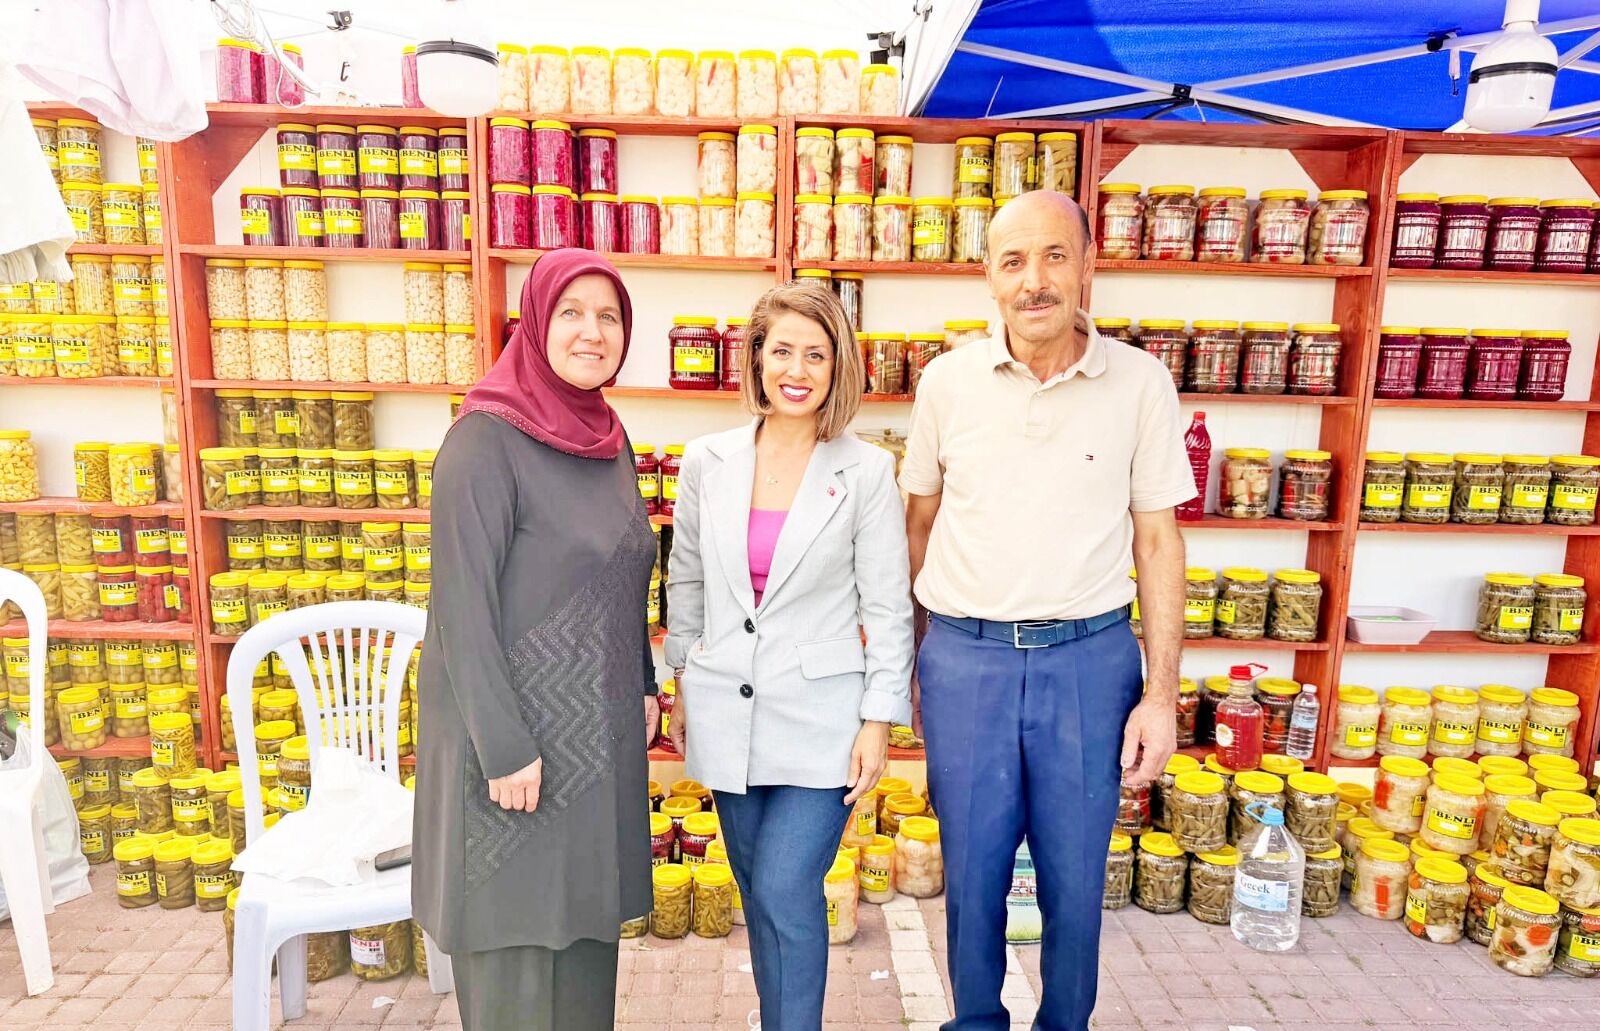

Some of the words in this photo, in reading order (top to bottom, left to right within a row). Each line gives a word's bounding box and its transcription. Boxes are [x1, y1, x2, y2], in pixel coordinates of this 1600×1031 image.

[60, 142, 98, 150] BENLI
[1528, 722, 1566, 734] BENLI
[1436, 810, 1474, 824] BENLI
